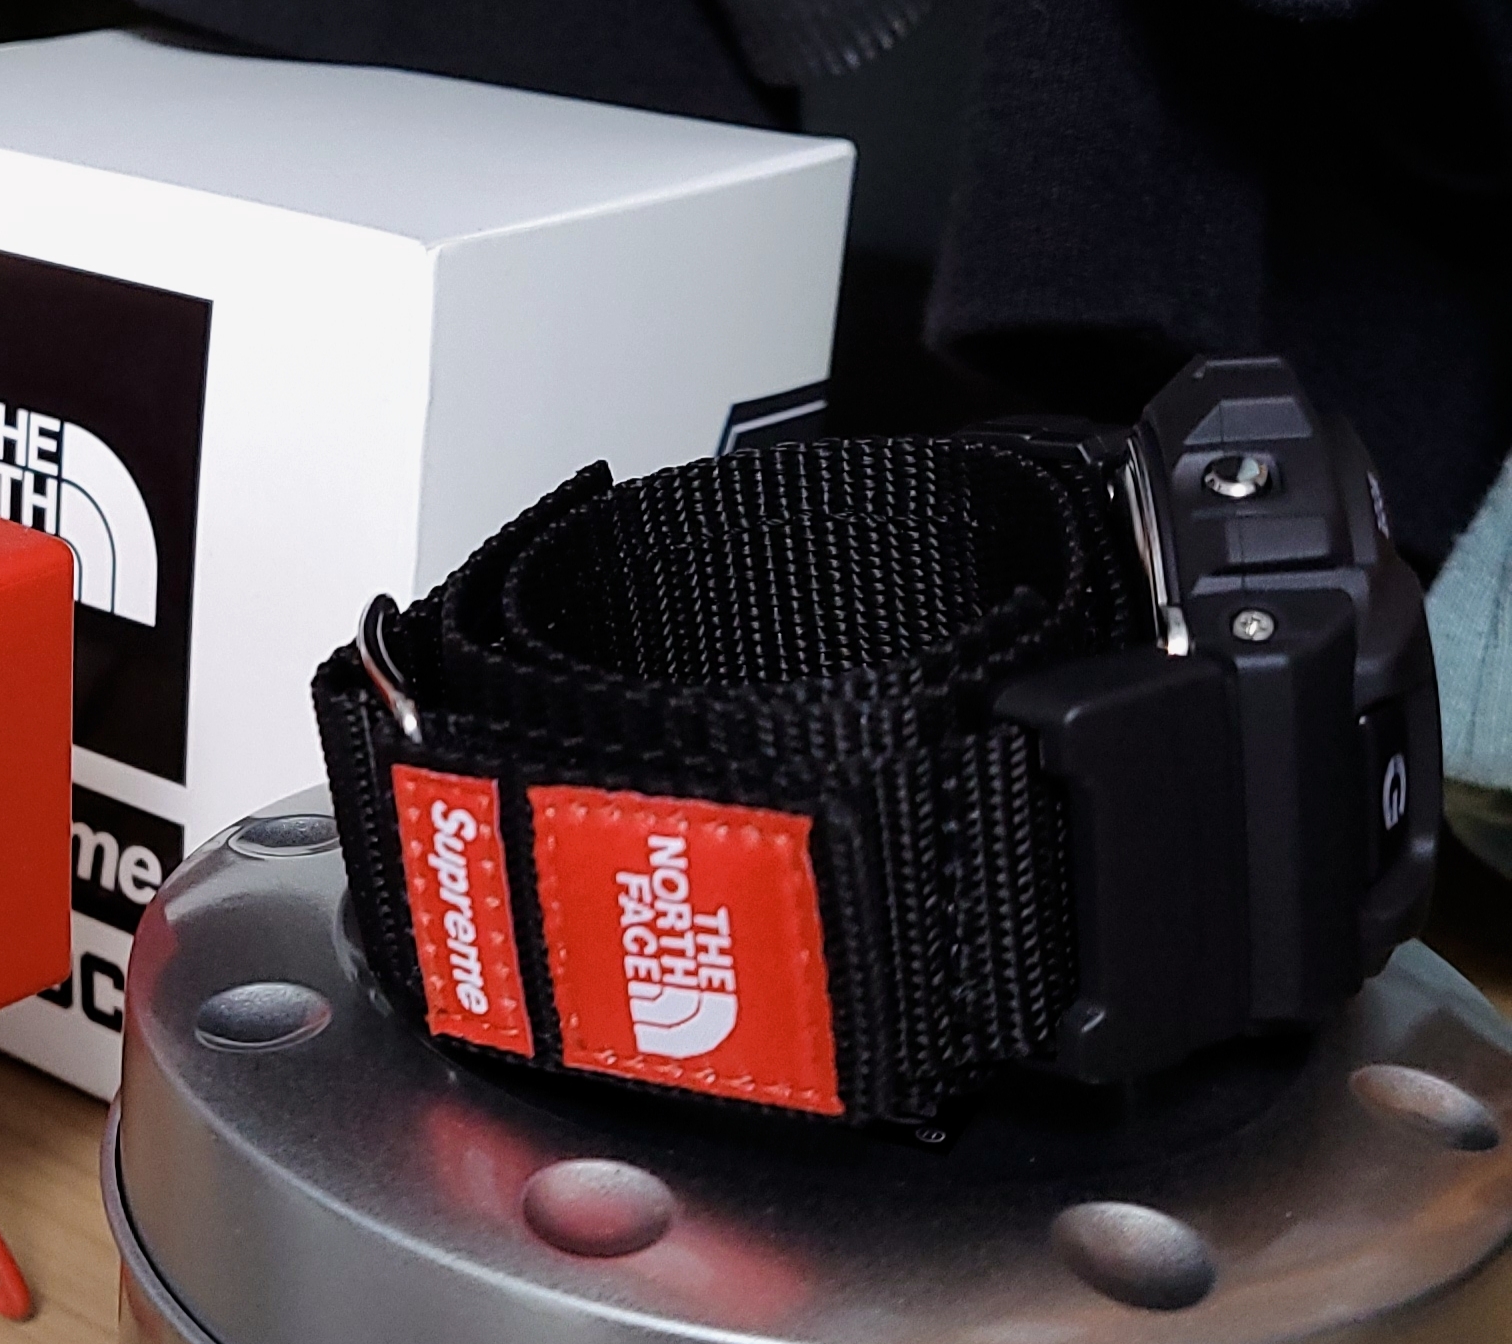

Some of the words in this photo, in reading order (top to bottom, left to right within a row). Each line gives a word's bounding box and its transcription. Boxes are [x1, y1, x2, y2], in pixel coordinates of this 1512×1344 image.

[430, 799, 489, 1015] Supreme
[615, 871, 662, 983] FACE
[647, 834, 699, 987] NORTH
[693, 905, 737, 993] THE
